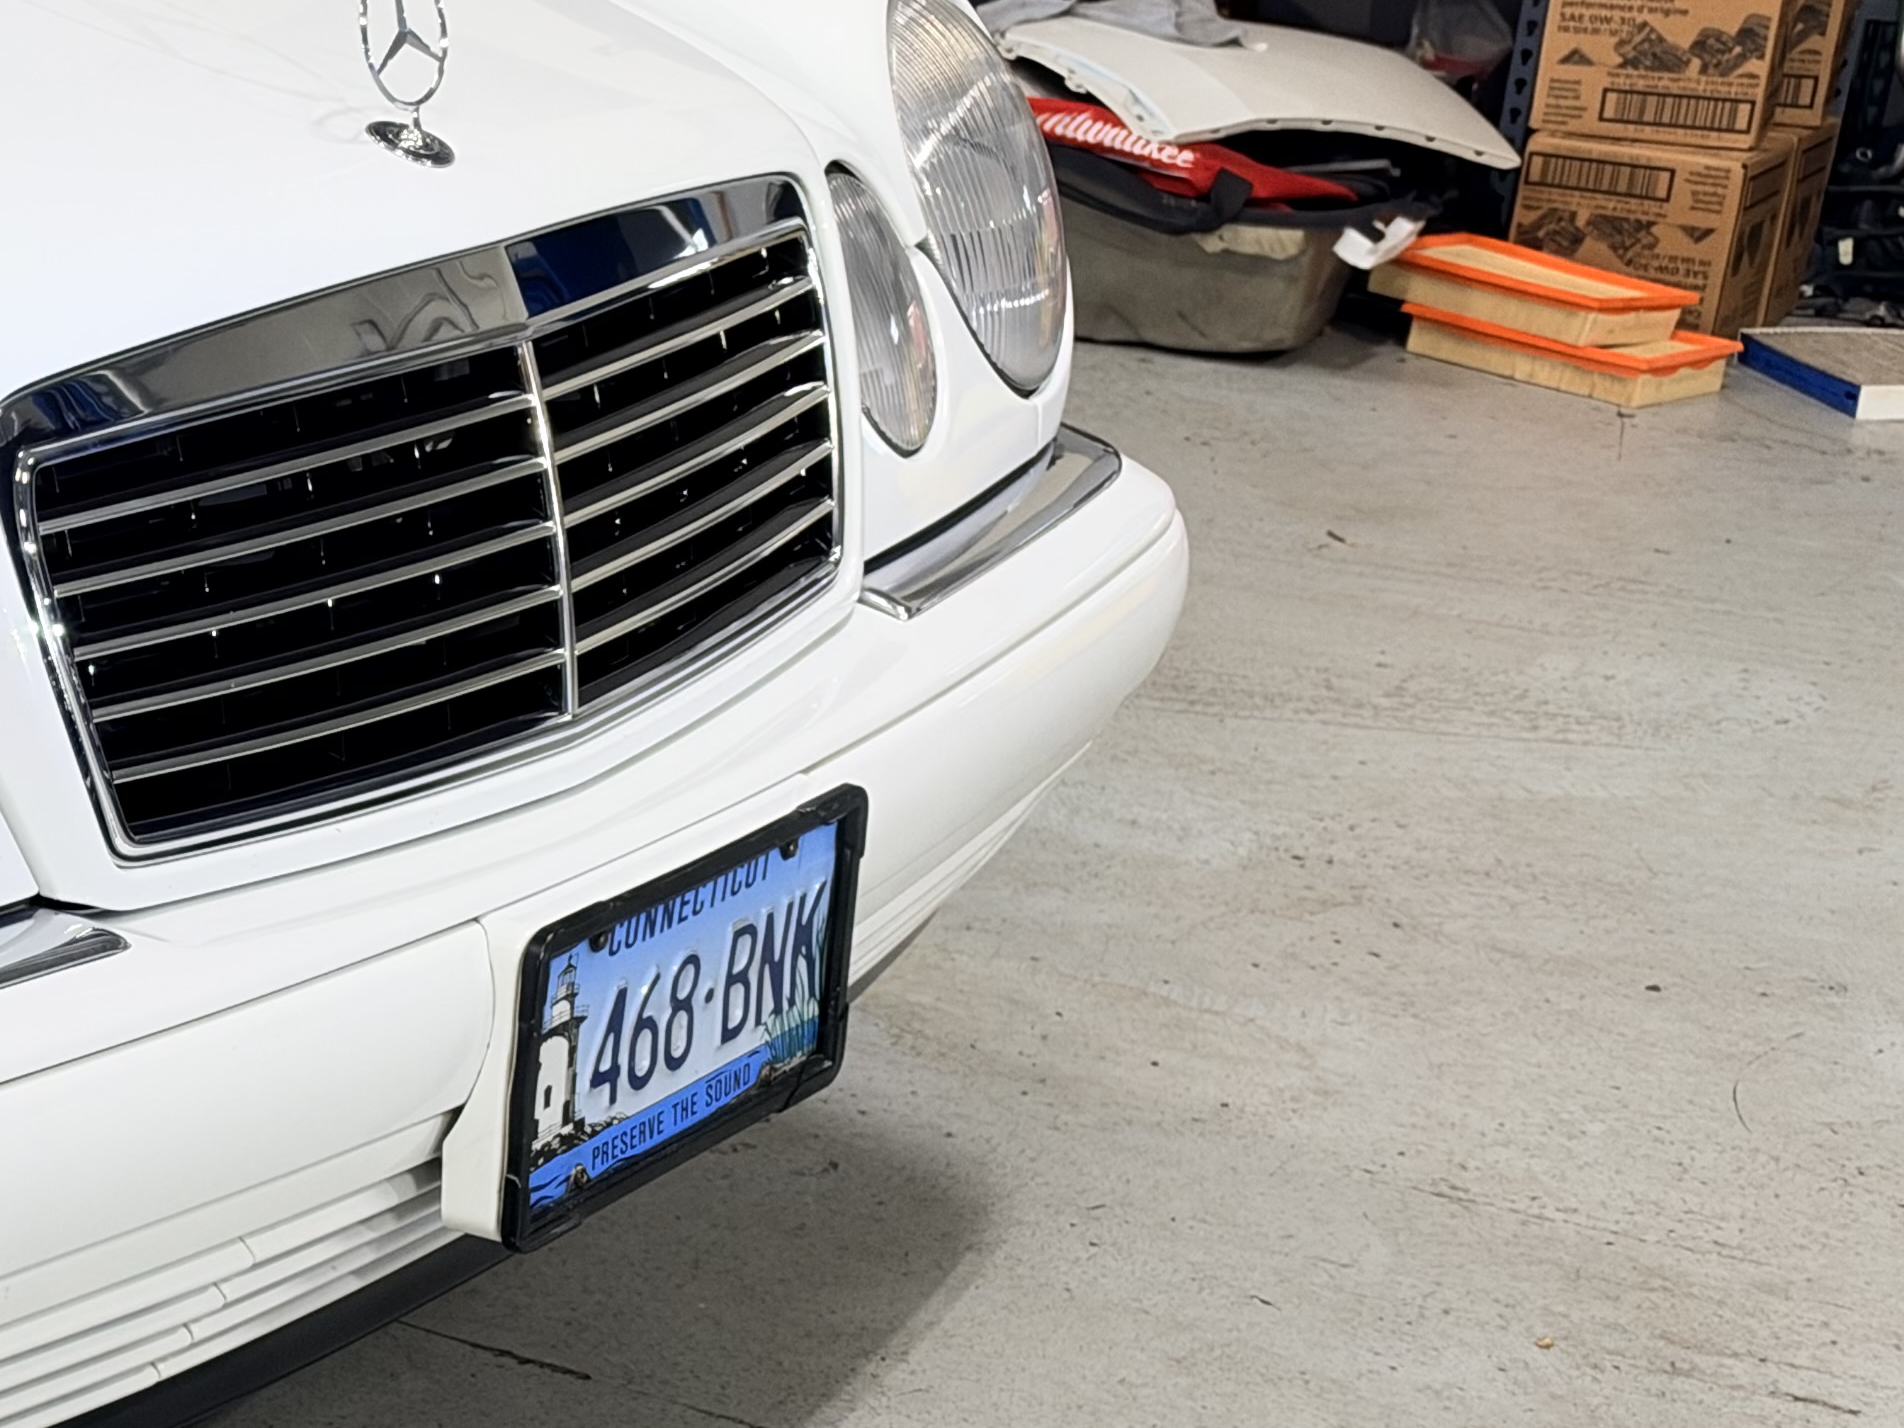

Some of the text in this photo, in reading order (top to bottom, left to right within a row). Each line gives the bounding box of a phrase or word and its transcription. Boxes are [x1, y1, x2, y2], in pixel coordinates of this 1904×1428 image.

[1559, 11, 1587, 24] SAE
[608, 853, 770, 957] CONNECTICUT
[592, 1063, 751, 1171] PRESERVE THE SOUND
